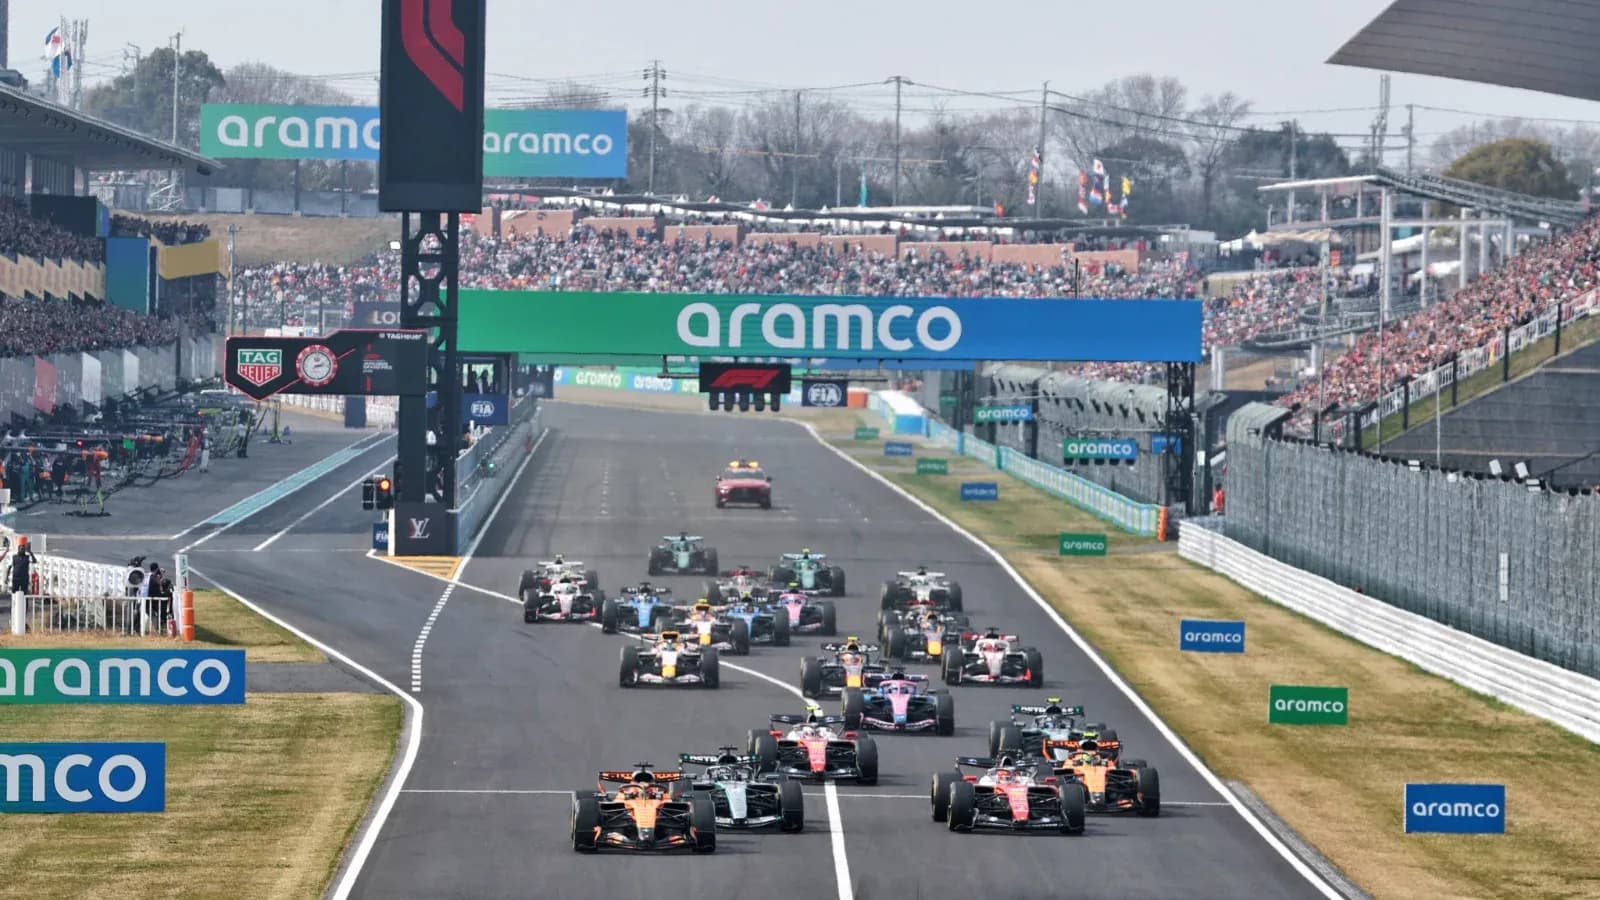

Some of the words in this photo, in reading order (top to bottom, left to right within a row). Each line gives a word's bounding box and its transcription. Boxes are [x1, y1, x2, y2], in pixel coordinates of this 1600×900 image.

[483, 131, 613, 155] aramco
[677, 302, 962, 351] aramco
[241, 352, 278, 363] TAG
[240, 366, 279, 384] HEUER
[811, 387, 838, 401] FIA
[471, 402, 493, 415] FIA
[978, 406, 1029, 419] aramco
[1067, 440, 1132, 455] aramco
[1063, 540, 1105, 550] aramco
[1185, 630, 1242, 643] aramco
[1275, 697, 1344, 713] aramco
[1412, 801, 1499, 817] aramco
